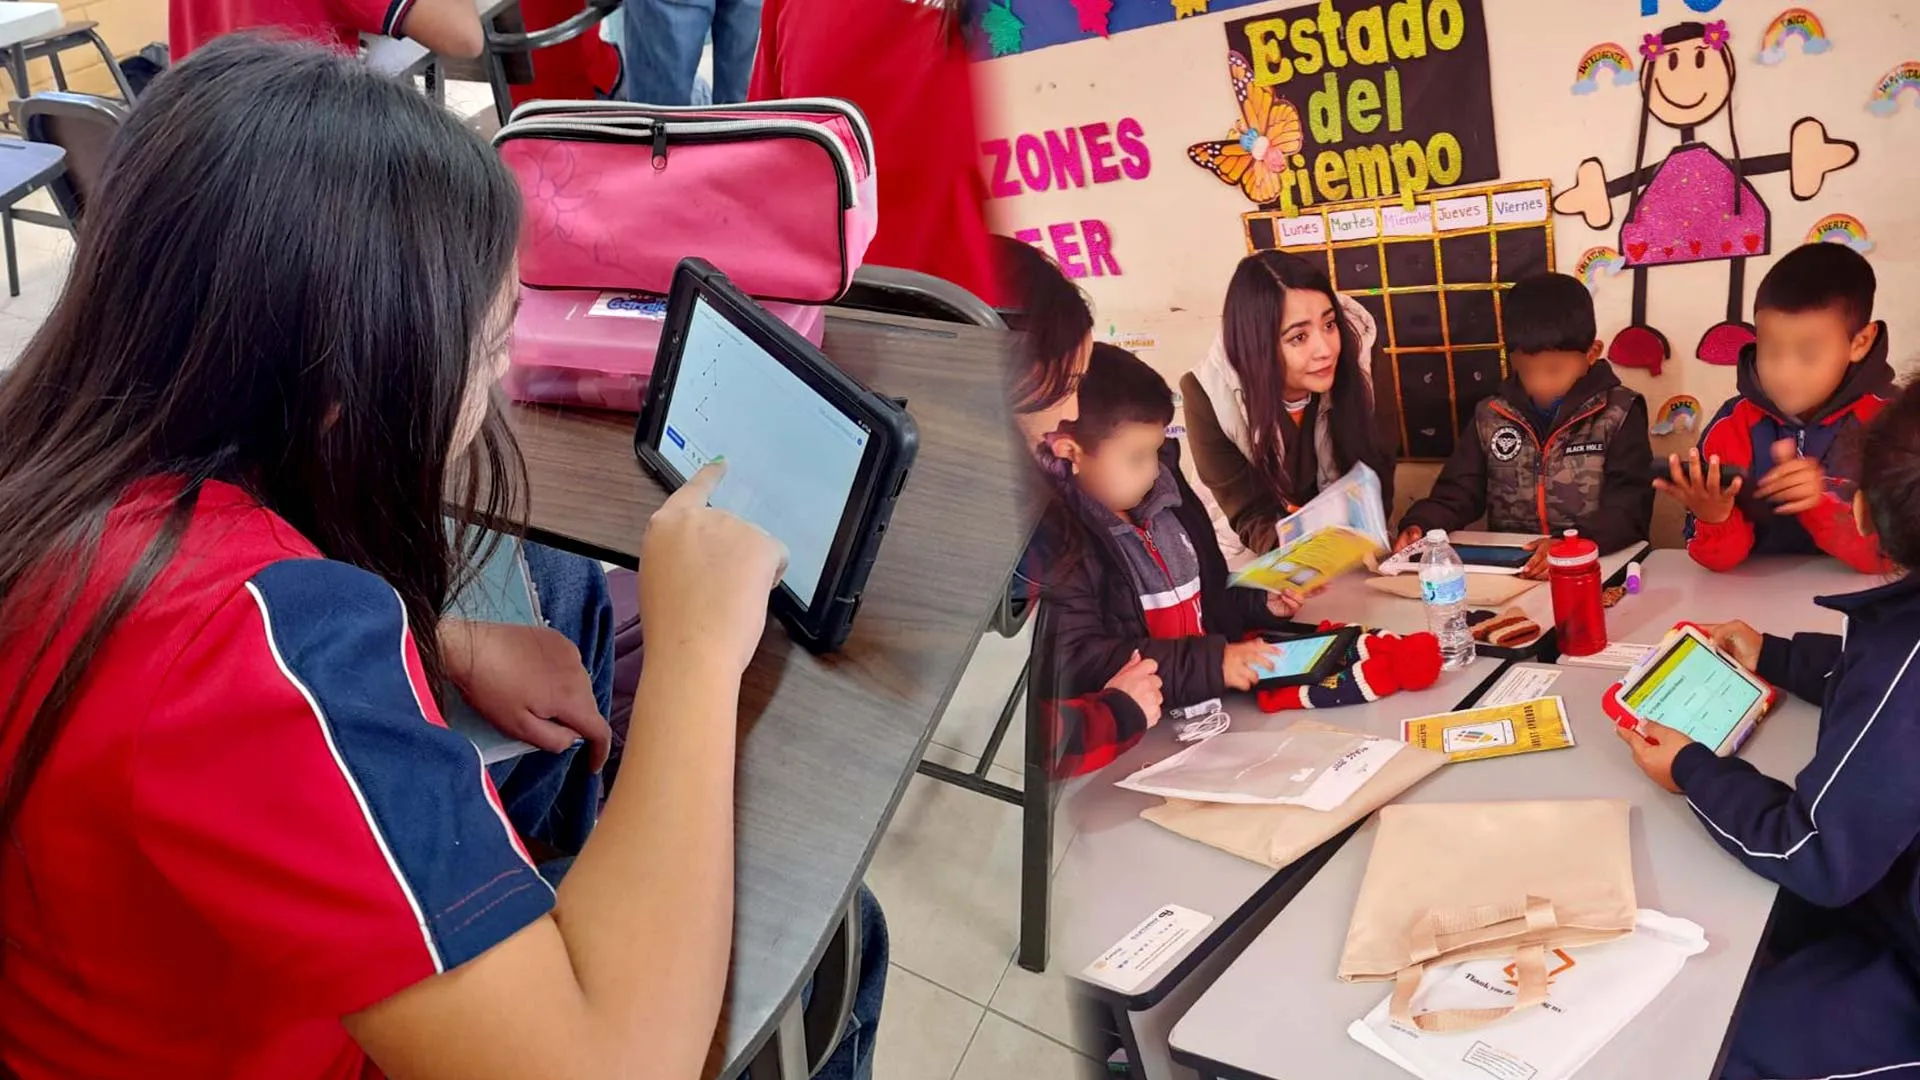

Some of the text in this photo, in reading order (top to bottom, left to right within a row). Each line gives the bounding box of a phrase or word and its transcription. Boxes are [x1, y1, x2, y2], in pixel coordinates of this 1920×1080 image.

[1244, 0, 1465, 87] Estado
[1308, 69, 1403, 144] del
[1282, 222, 1319, 238] Lunes
[1330, 214, 1375, 233] Martes
[1438, 206, 1481, 222] Jueves
[1495, 199, 1544, 216] Viernes
